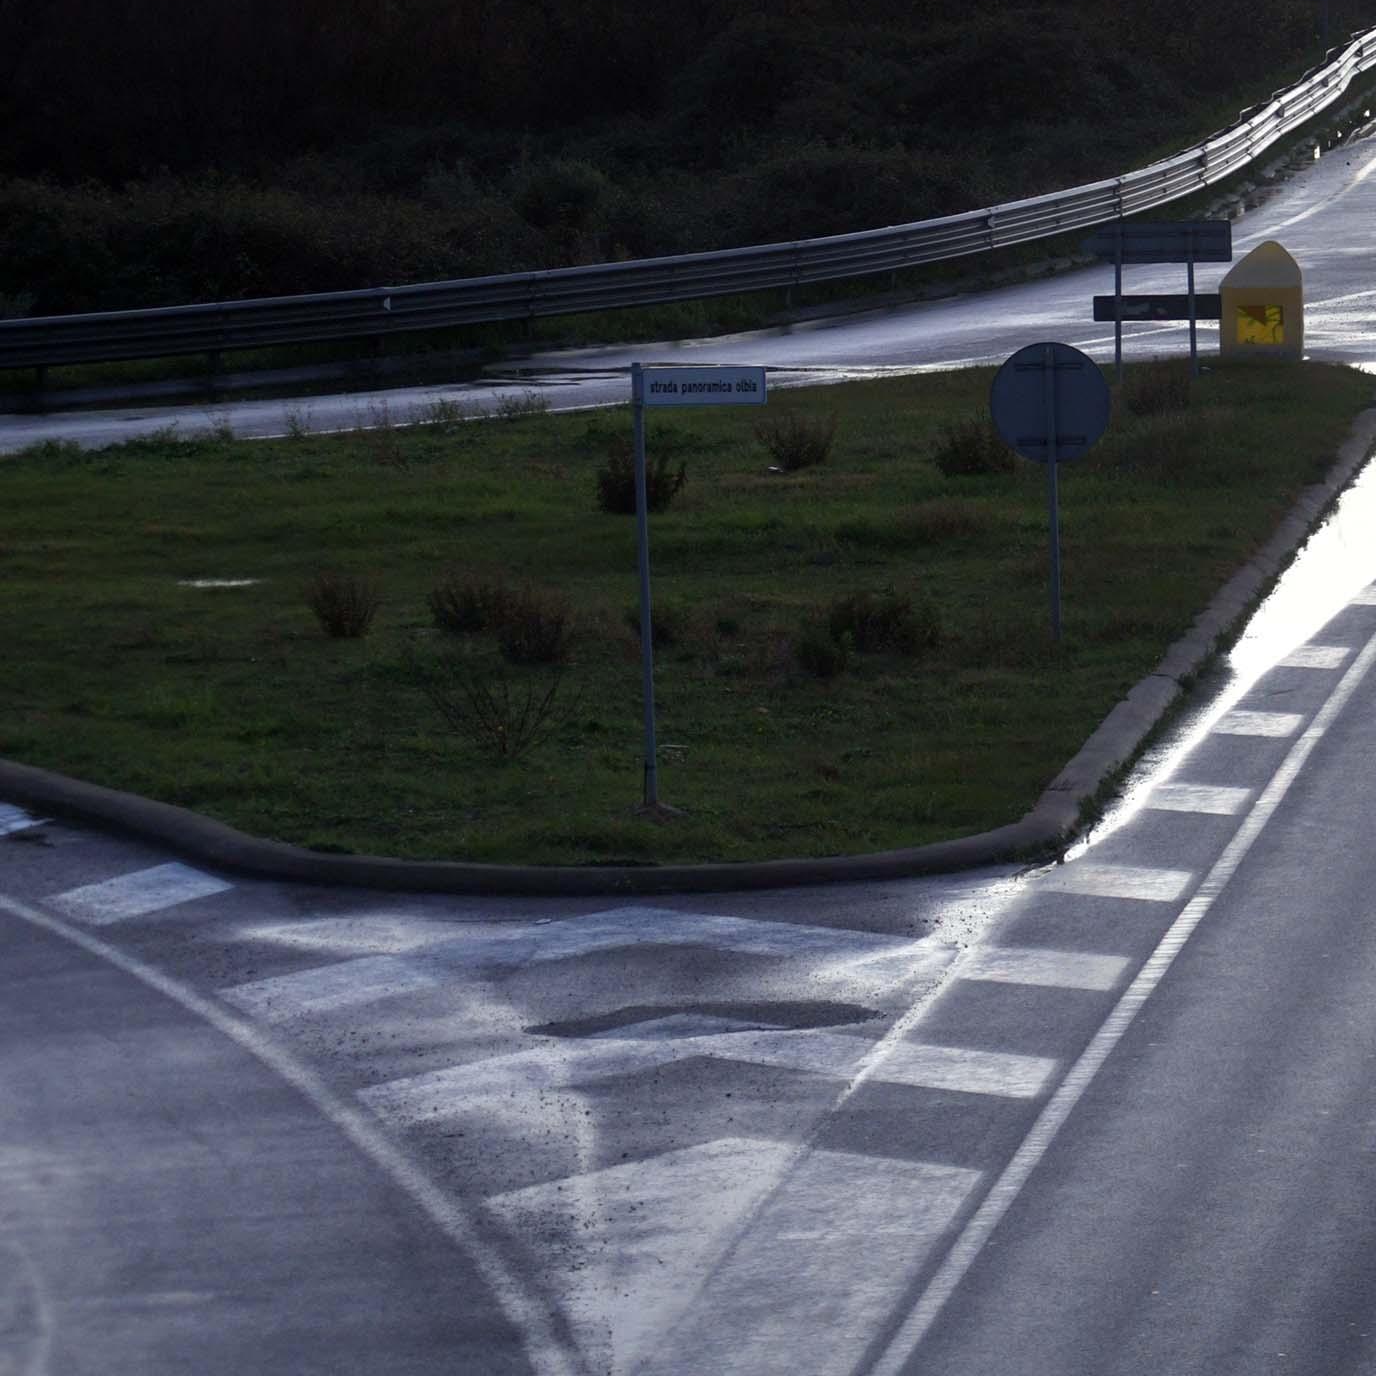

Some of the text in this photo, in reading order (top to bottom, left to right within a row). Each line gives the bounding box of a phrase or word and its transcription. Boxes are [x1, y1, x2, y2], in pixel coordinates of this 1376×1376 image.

[650, 379, 757, 395] strada panoramica olbia
